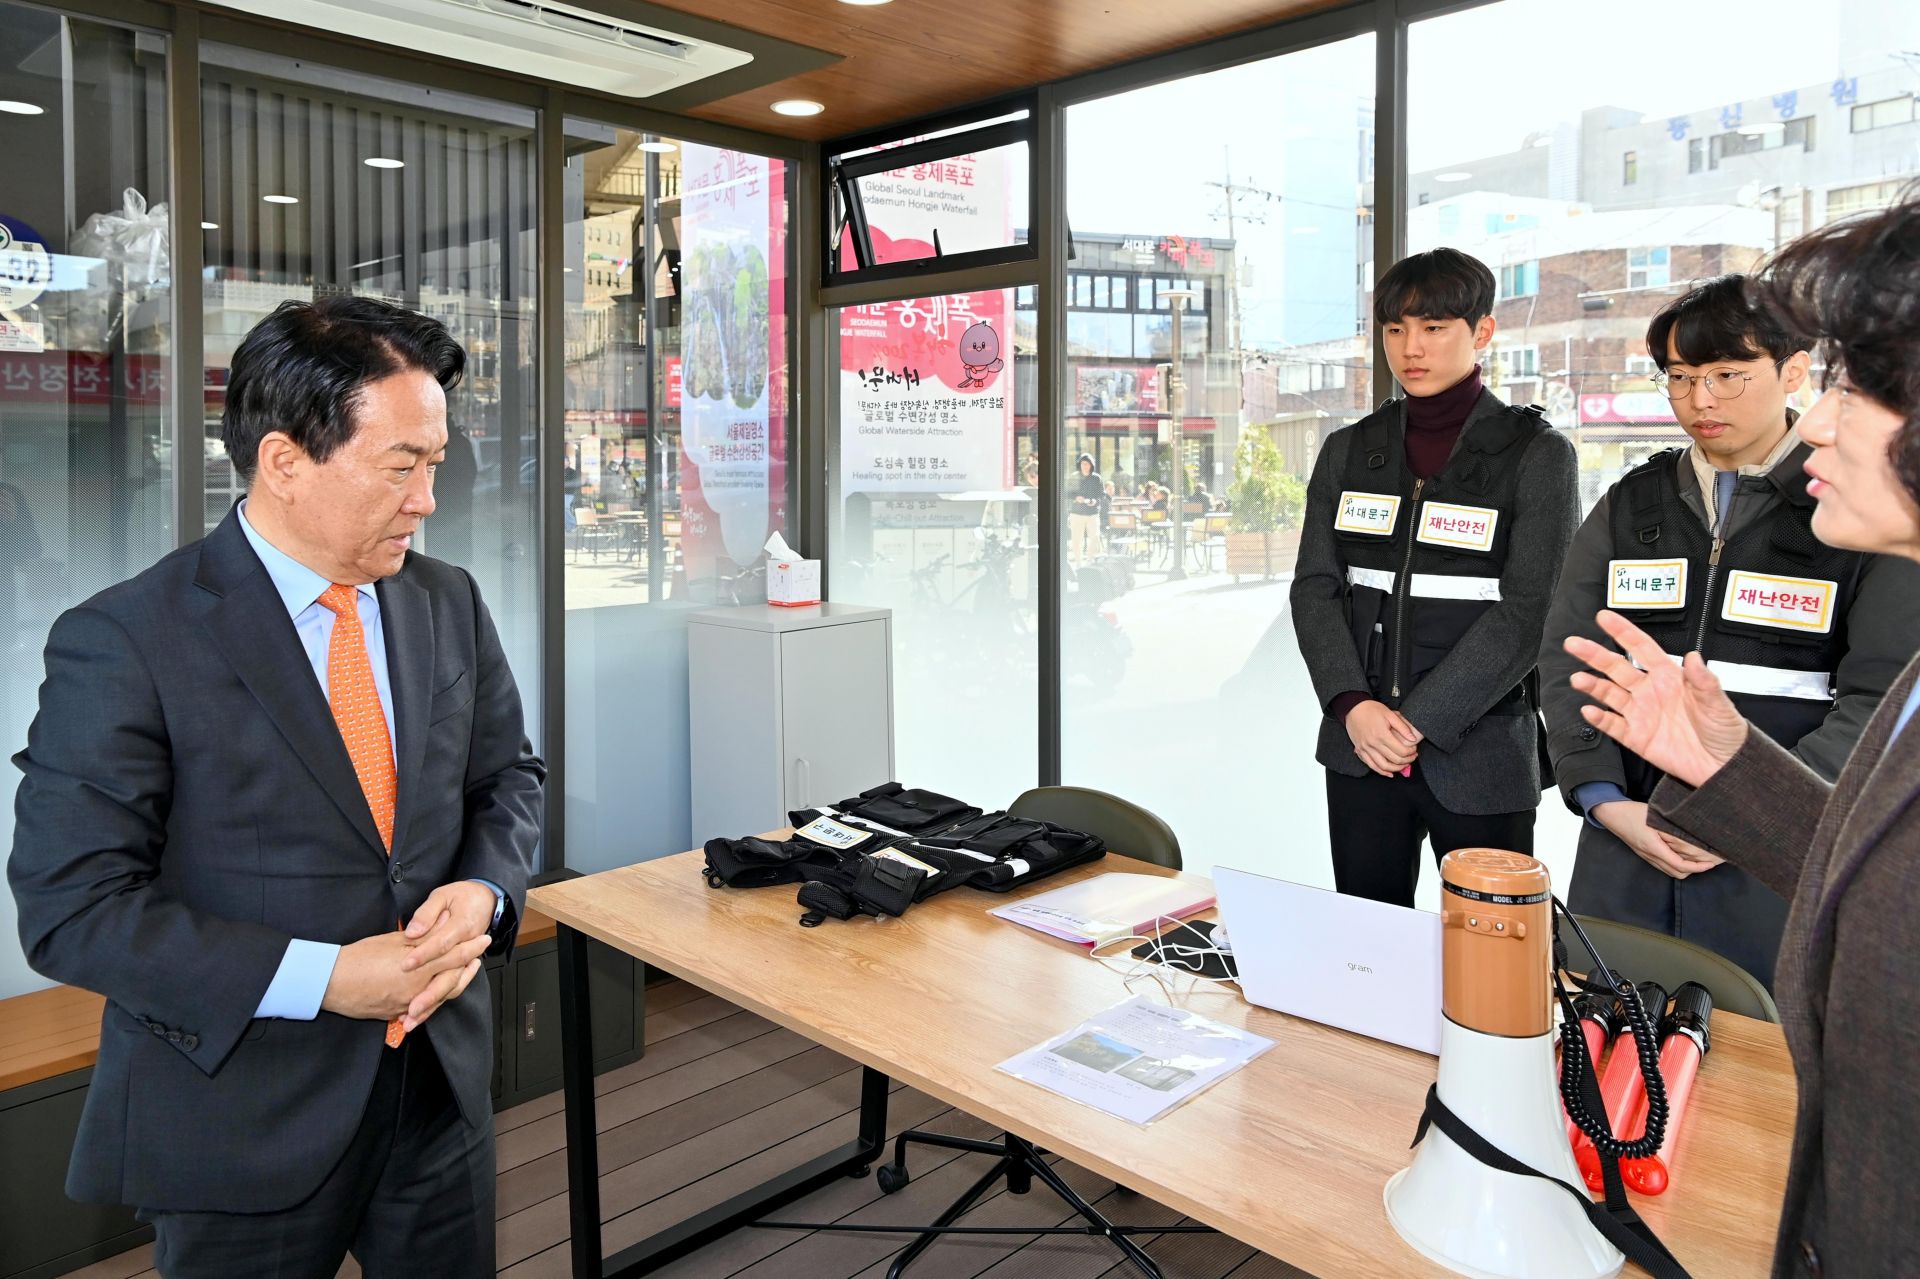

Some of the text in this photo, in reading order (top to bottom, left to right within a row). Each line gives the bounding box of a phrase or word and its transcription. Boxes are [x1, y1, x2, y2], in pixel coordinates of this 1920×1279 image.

[865, 180, 967, 203] Global Seoul Landmark
[907, 198, 939, 212] Hongje
[941, 202, 978, 216] Waterfall
[1121, 238, 1156, 254] 서대문
[858, 425, 964, 437] Global Waterside Attraction
[873, 457, 949, 470] 도심속 힐링 명소
[852, 471, 968, 482] Healing spot in the city center
[1344, 506, 1390, 521] 서대문구
[1428, 516, 1486, 536] 재난안전
[1617, 577, 1676, 592] 서대문구
[1737, 588, 1820, 613] 재난안전
[1492, 895, 1514, 904] MODEL
[1347, 962, 1373, 974] gram
